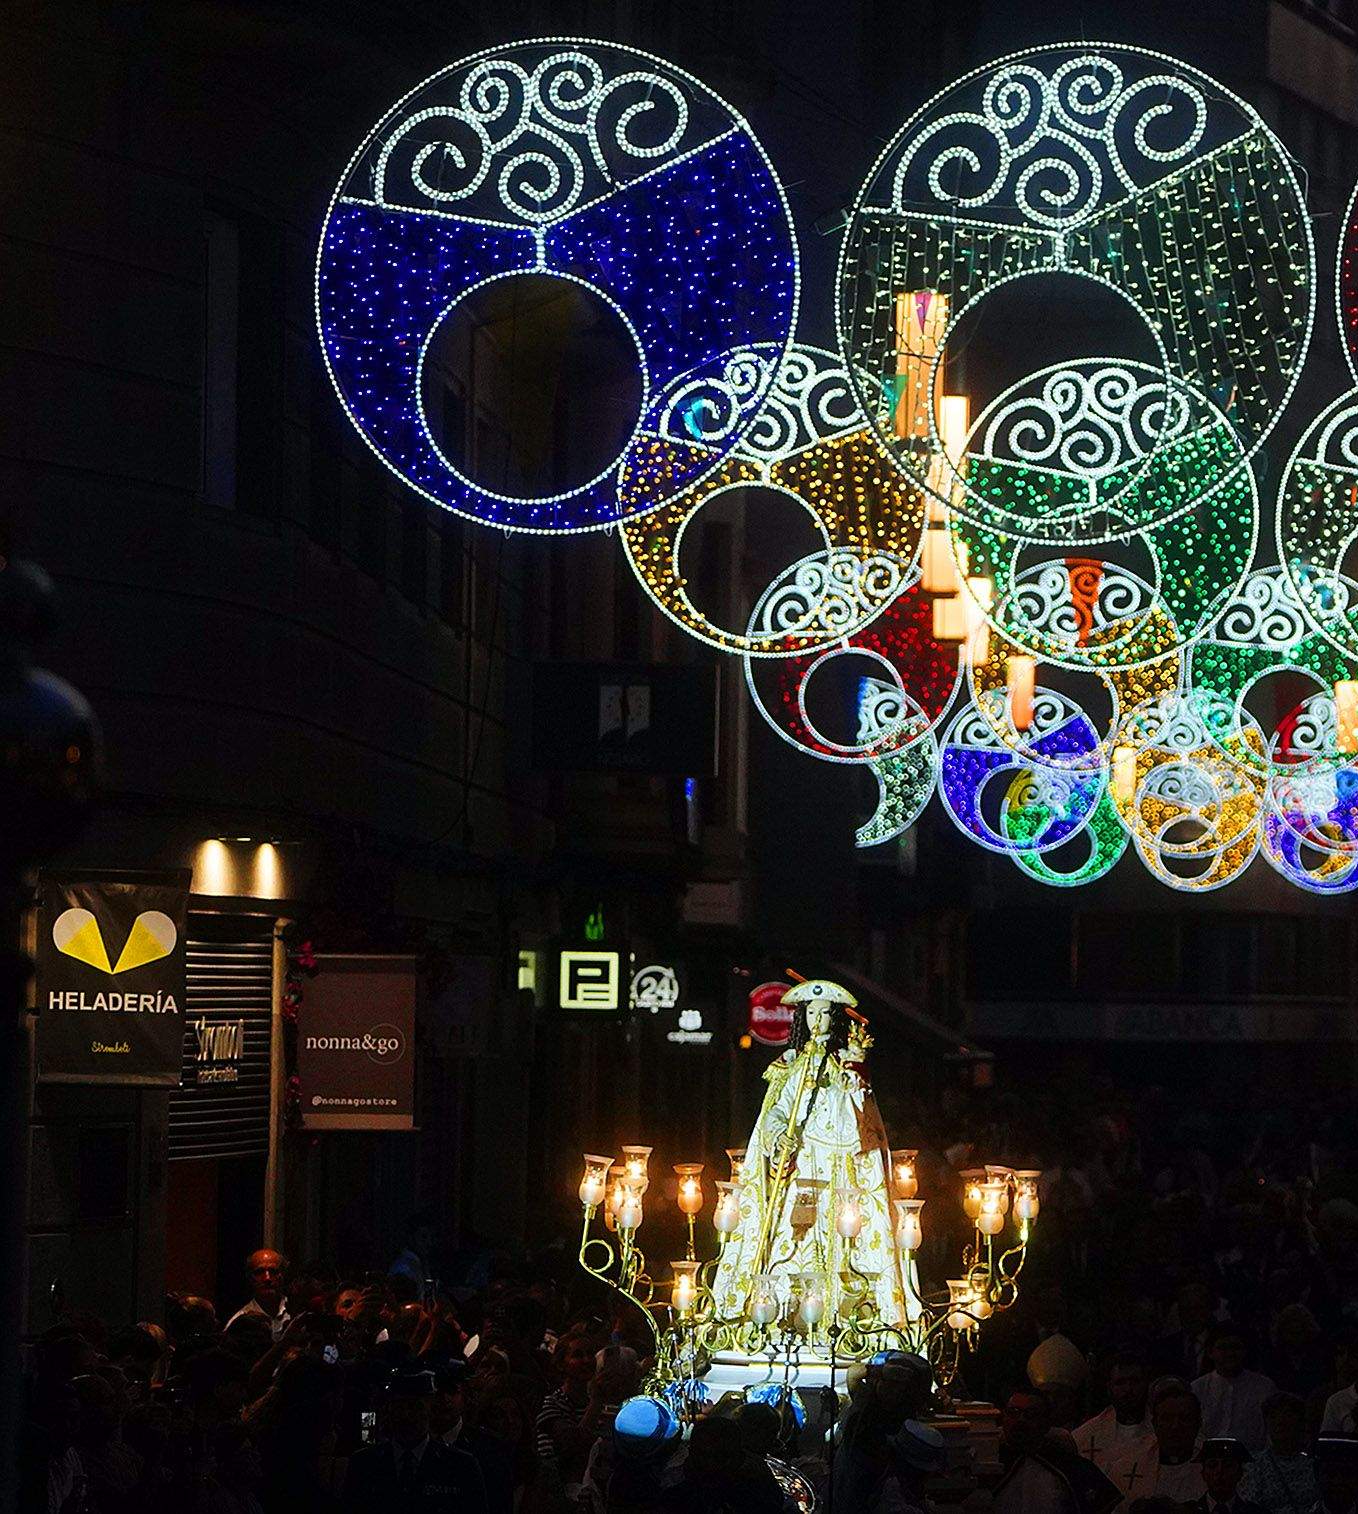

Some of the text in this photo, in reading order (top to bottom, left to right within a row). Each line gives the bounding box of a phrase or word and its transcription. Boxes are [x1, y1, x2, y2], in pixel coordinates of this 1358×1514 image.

[48, 989, 178, 1014] HELADERÍA
[306, 1033, 399, 1055] nonna&go
[311, 1095, 398, 1107] @nonnagostore
